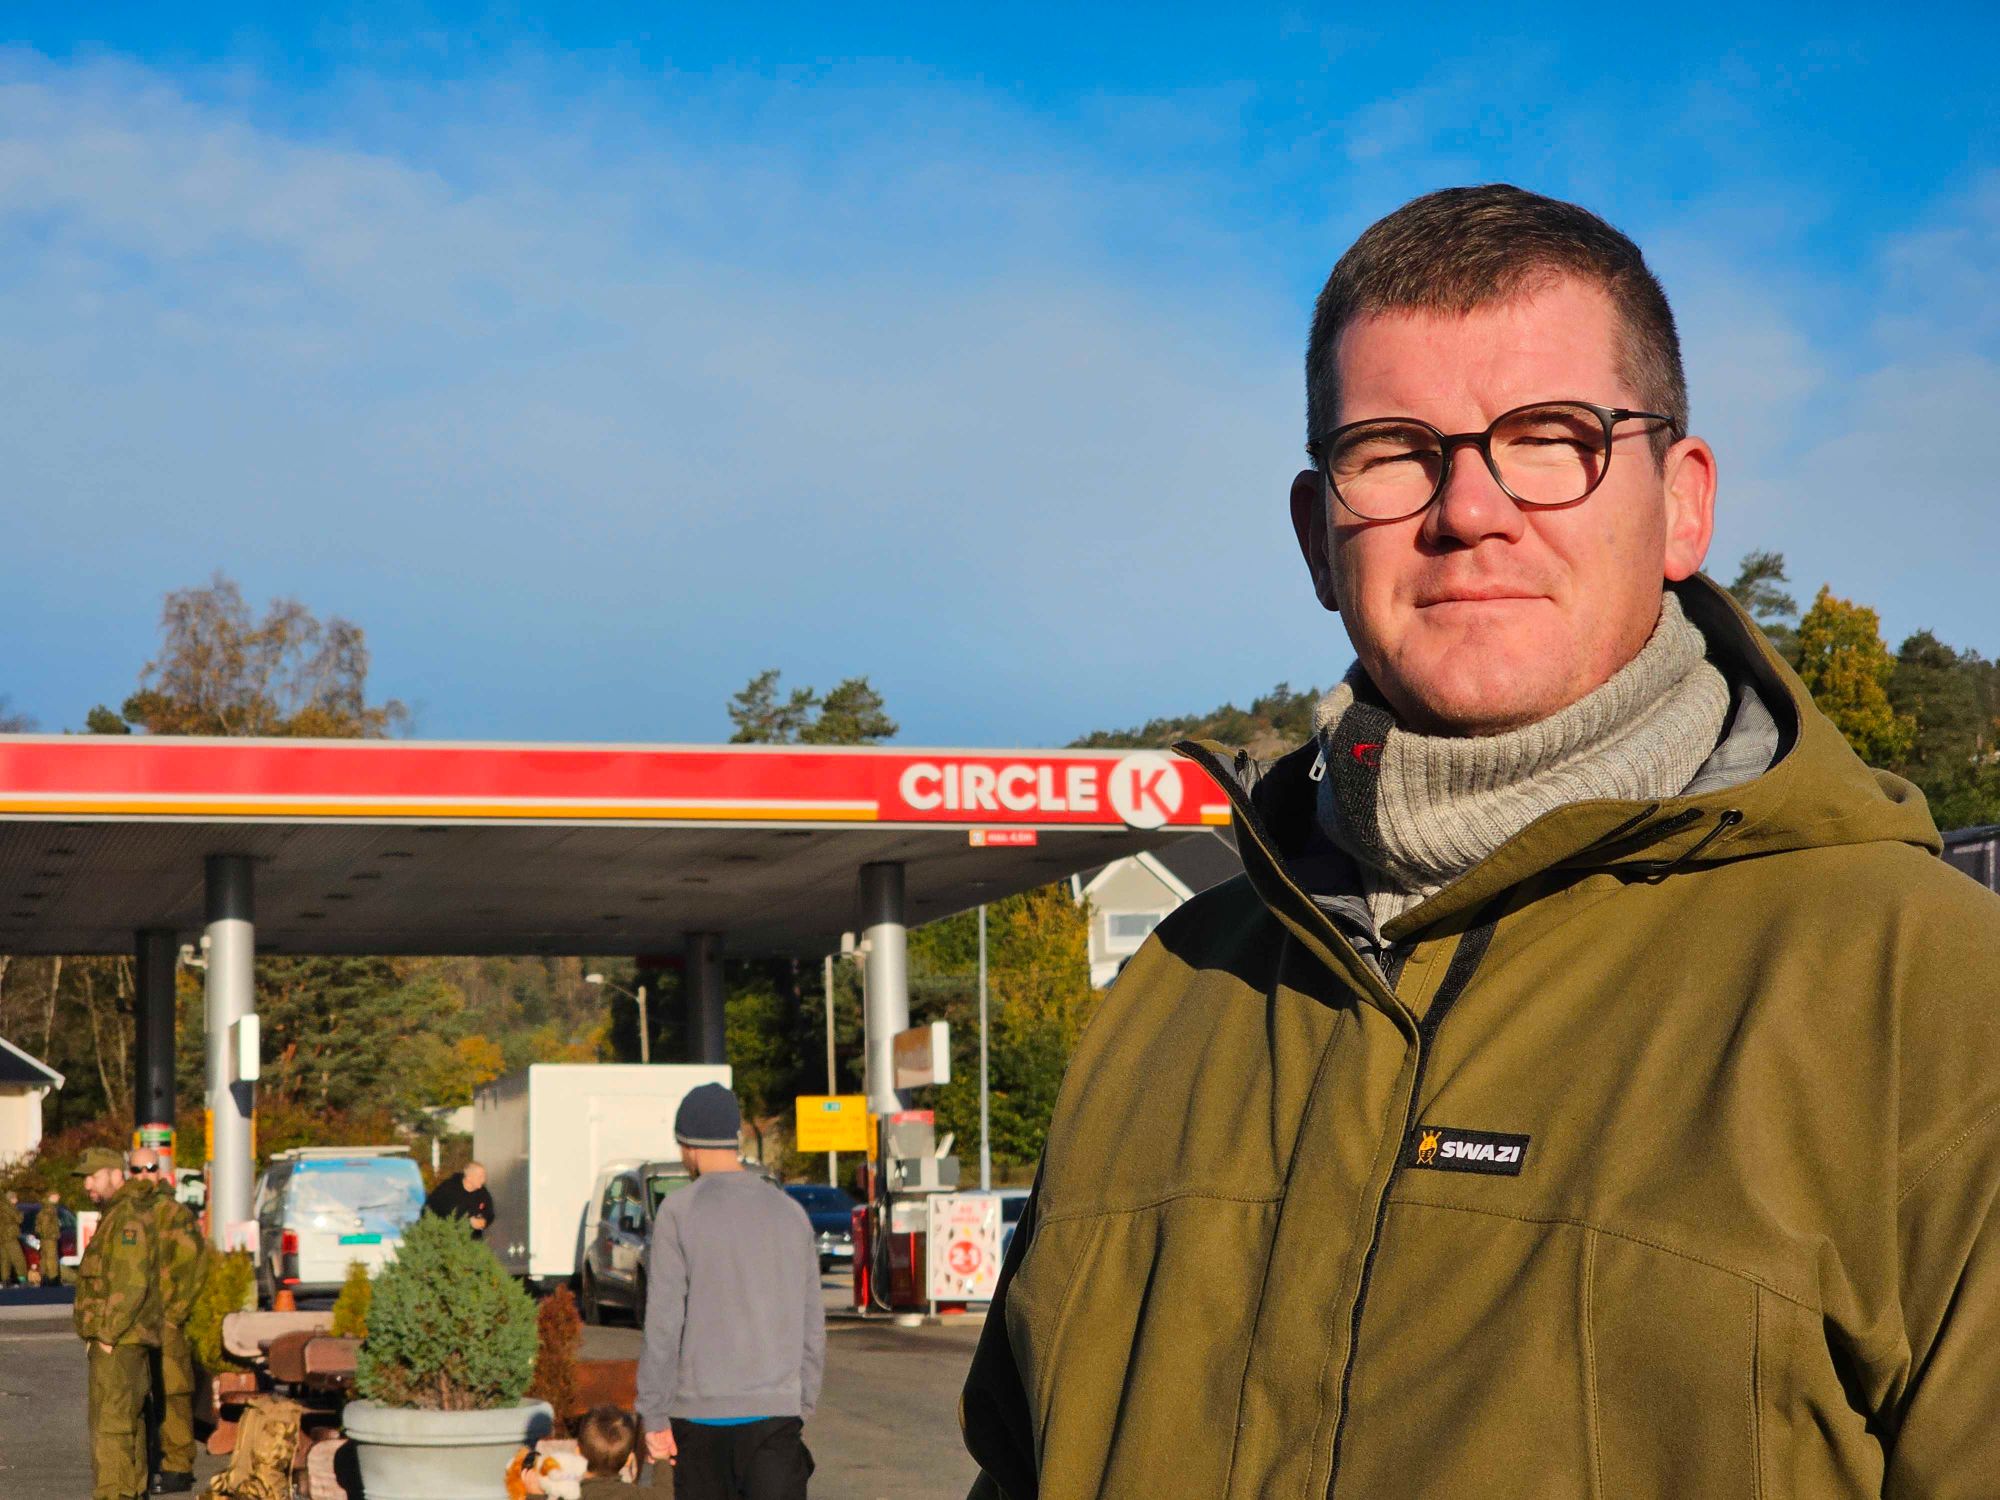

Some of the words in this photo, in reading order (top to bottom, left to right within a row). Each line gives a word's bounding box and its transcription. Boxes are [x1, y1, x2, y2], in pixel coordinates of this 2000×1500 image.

[900, 763, 1098, 812] CIRCLE
[1127, 766, 1177, 825] K
[1440, 1141, 1521, 1163] SWAZI
